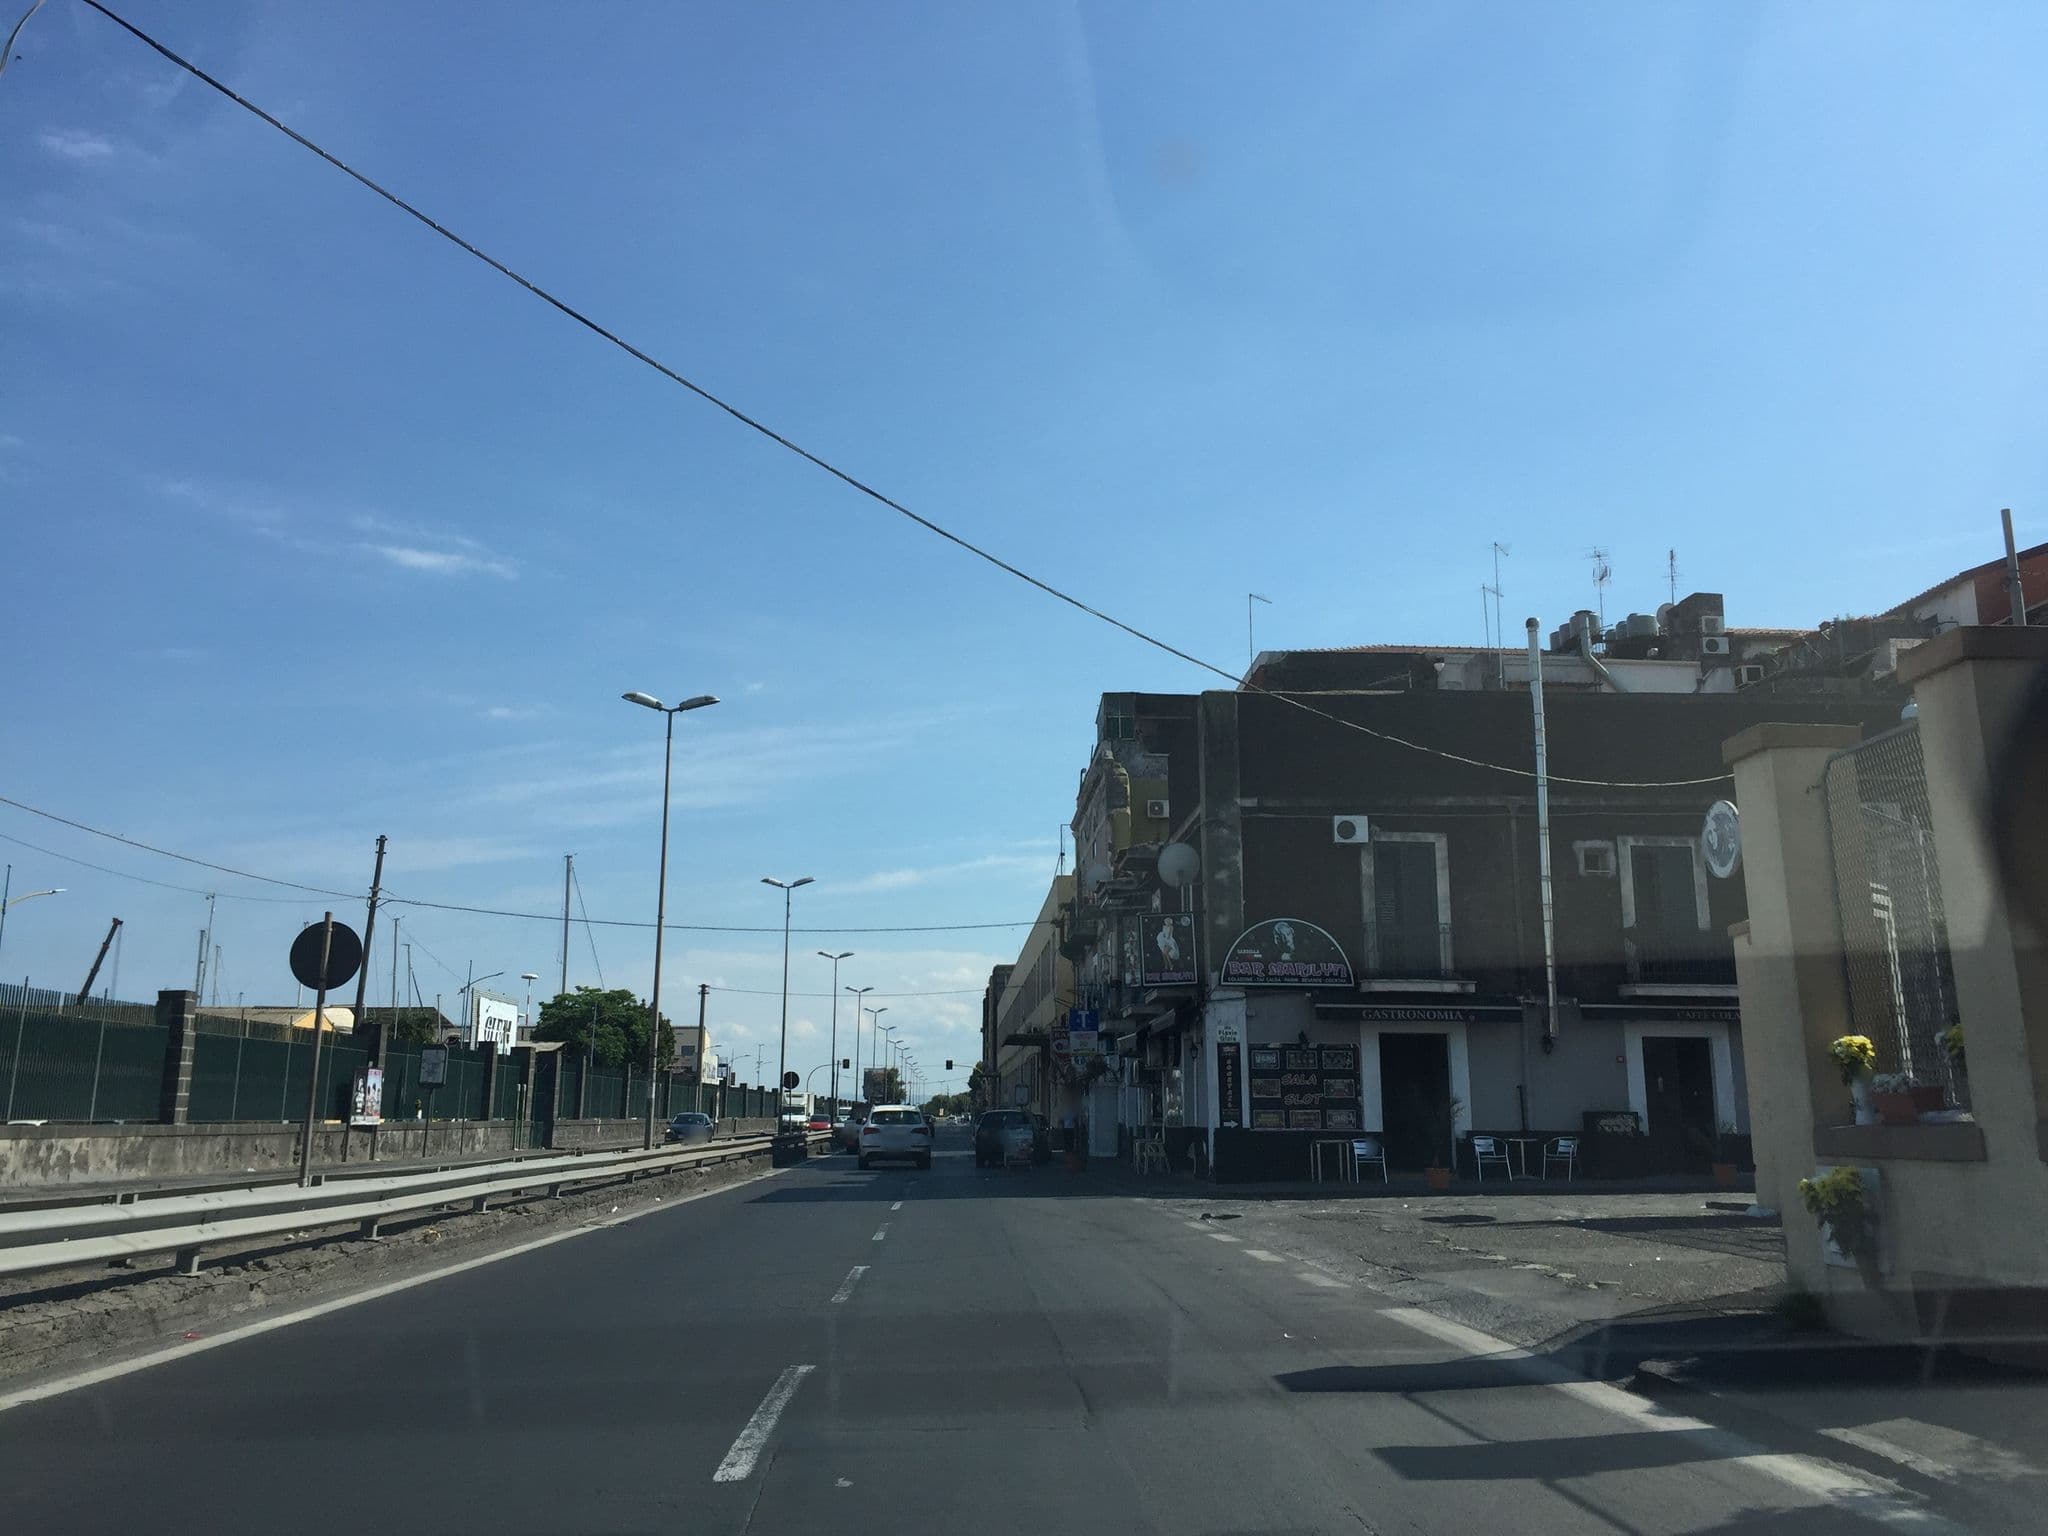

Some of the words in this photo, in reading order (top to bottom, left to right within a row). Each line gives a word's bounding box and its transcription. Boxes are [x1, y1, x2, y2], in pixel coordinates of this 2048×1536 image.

[1228, 961, 1265, 977] BAR
[1362, 1009, 1464, 1020] GASTRONOMIA
[1281, 1073, 1317, 1085] SALA
[1284, 1093, 1323, 1105] SLOT
